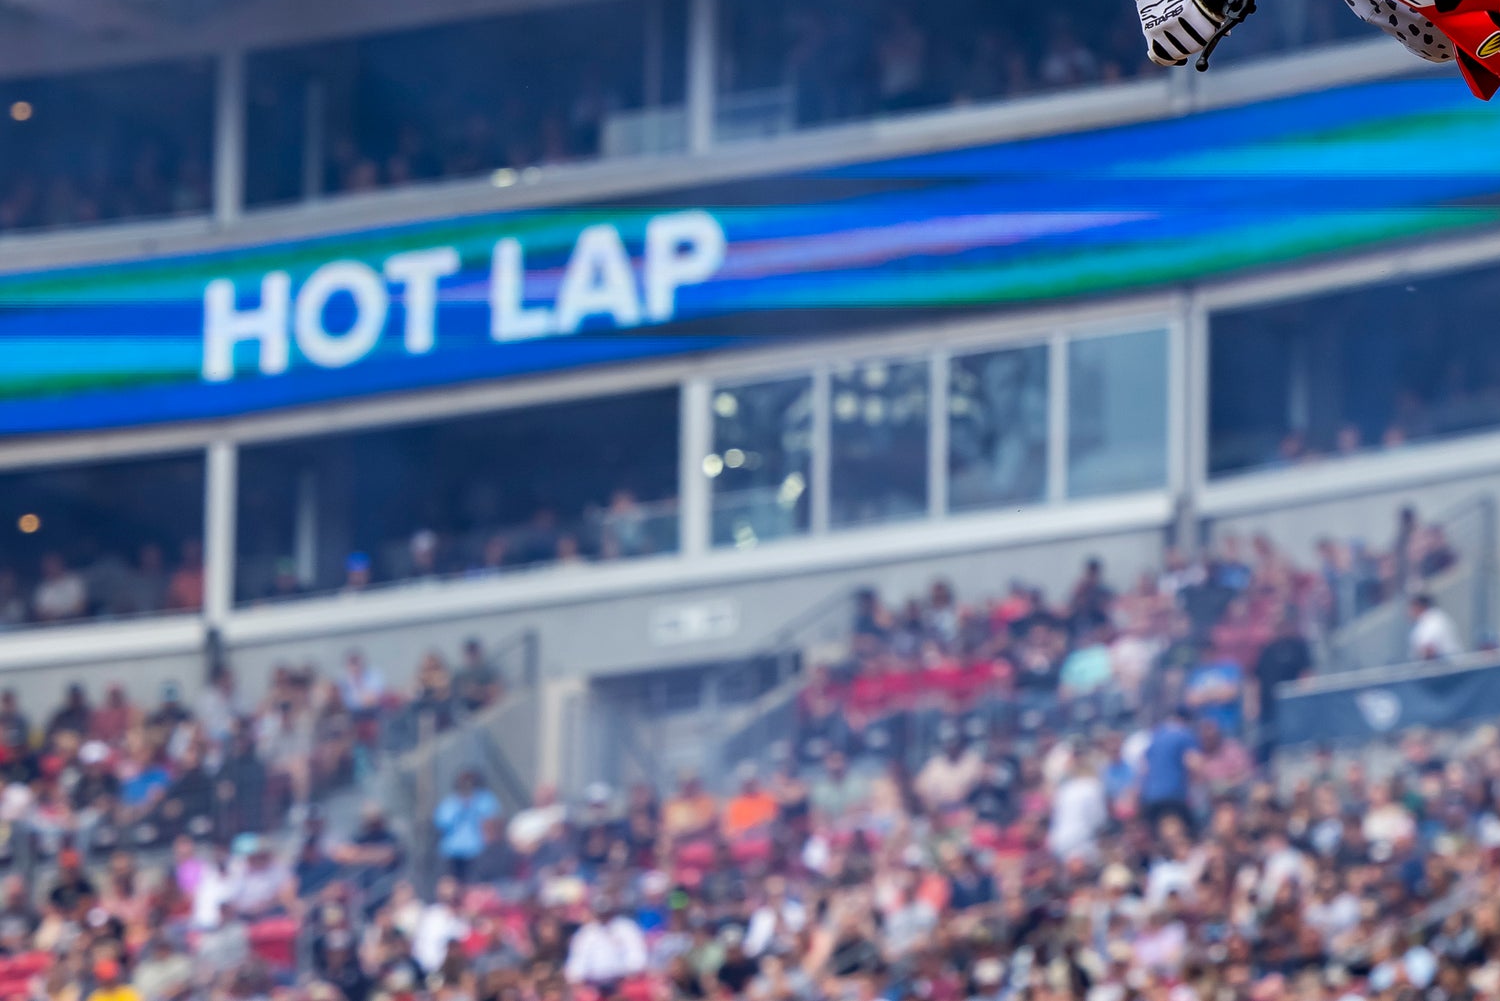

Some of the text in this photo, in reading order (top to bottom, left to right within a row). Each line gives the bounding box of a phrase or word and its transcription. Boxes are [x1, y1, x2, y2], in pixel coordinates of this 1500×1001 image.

[1144, 4, 1184, 31] ASTARS
[202, 208, 727, 384] HOT LAP
